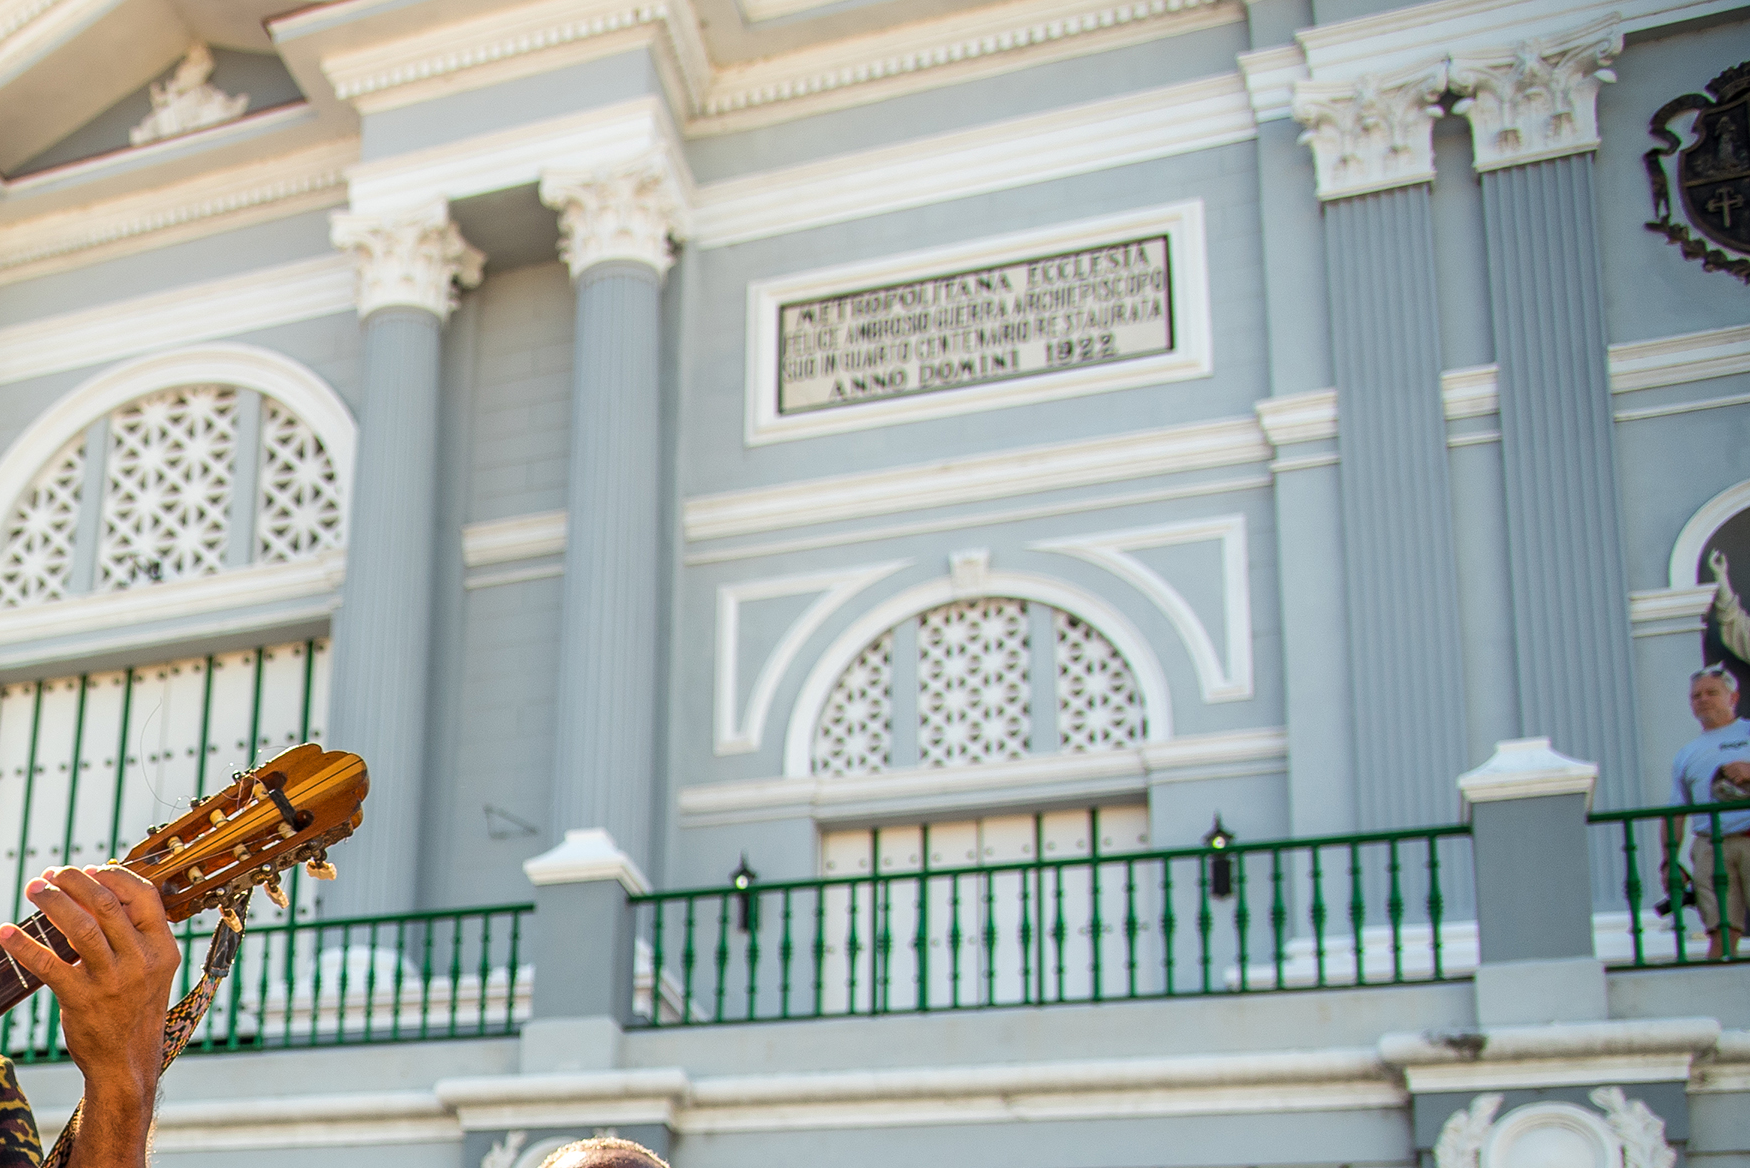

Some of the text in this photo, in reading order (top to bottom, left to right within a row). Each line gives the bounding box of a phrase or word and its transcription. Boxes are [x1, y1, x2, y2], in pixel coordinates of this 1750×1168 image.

[797, 246, 1150, 329] METROPOLITANA ECCLESIA
[828, 332, 1117, 401] ANNO DOMINI 1922
